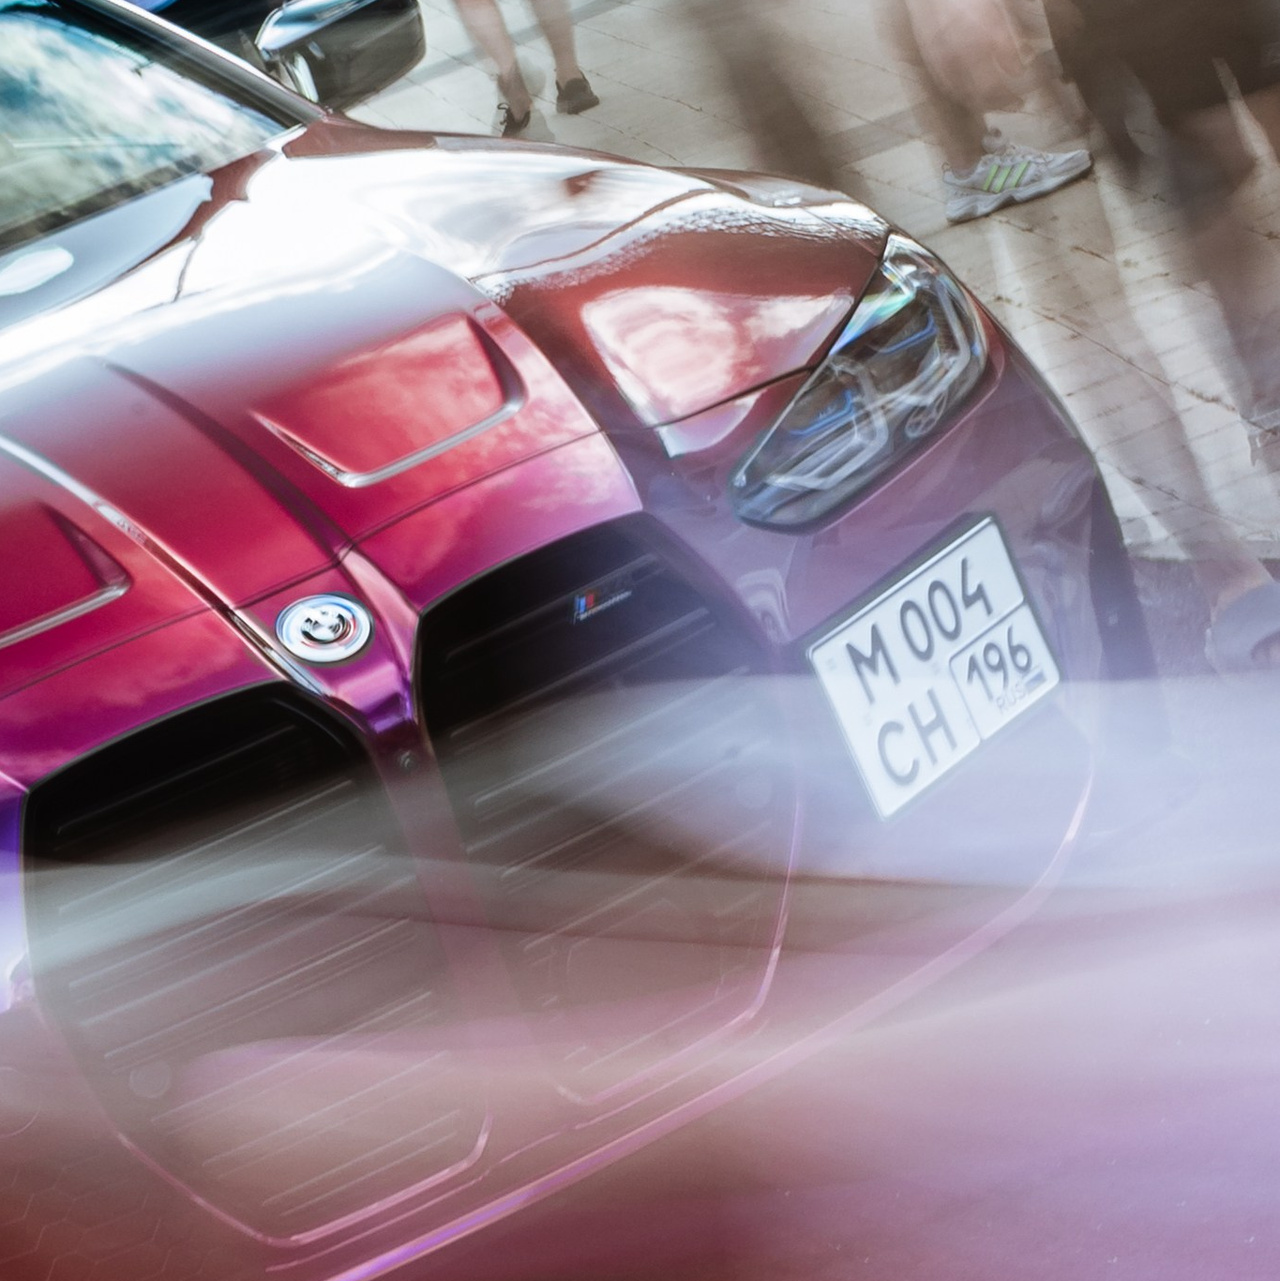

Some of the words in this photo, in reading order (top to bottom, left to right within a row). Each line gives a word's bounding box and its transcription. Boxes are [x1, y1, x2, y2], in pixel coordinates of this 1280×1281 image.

[900, 557, 994, 663] 004
[966, 624, 1033, 703] 196
[995, 682, 1027, 715] RUS
